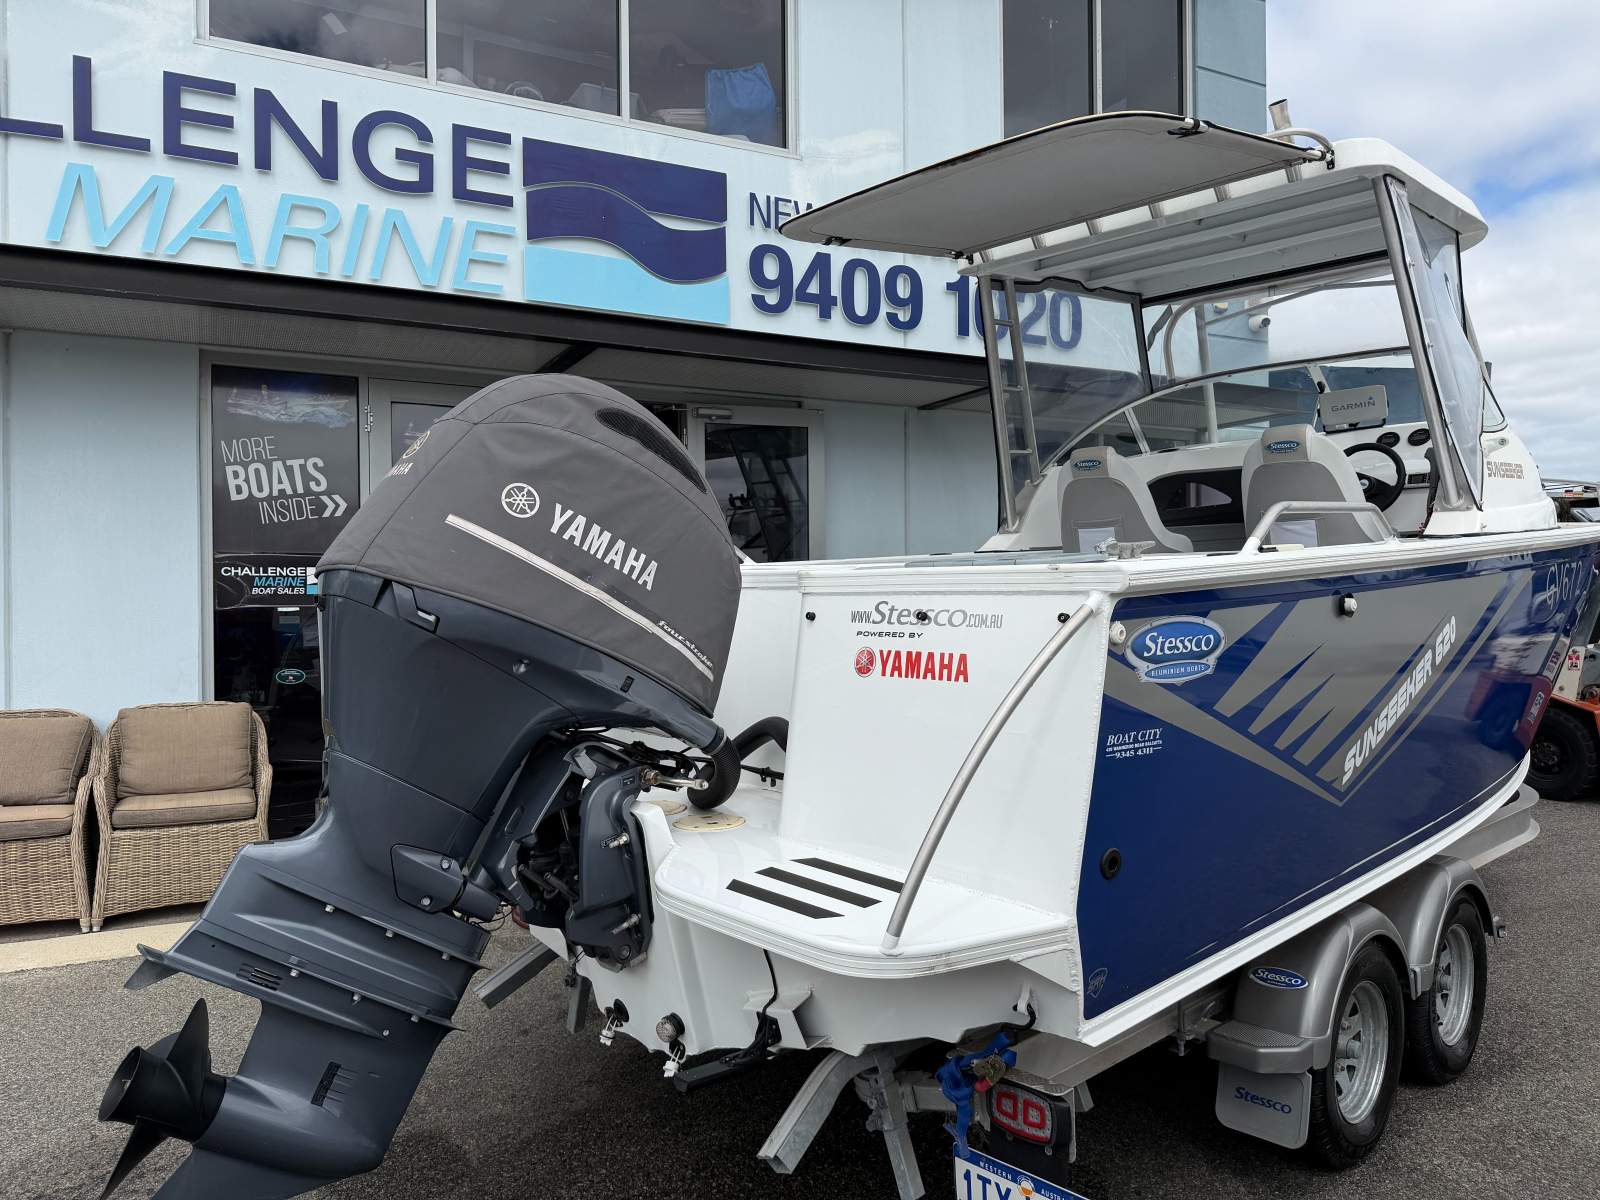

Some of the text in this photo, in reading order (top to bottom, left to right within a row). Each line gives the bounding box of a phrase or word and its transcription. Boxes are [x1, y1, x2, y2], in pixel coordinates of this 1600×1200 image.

[0, 55, 514, 208] LENGE
[45, 162, 517, 293] MARINE
[748, 244, 924, 331] 9409
[1331, 400, 1376, 412] GARMIN
[221, 436, 278, 463] MORE
[225, 457, 328, 501] BOATS
[258, 496, 319, 524] INSIDE
[550, 502, 658, 590] YAMAHA
[221, 566, 306, 576] CHALLENGE
[253, 577, 305, 586] MARINE
[251, 587, 305, 595] BOAT SALES
[856, 630, 905, 638] POWERED
[1143, 632, 1215, 657] Stessco
[878, 648, 969, 683] YAMAHA
[1342, 615, 1456, 785] SUNSEEKER 620
[1107, 732, 1136, 746] BOAT
[1138, 728, 1162, 742] CITY
[1255, 968, 1302, 985] Stessco
[1234, 1086, 1292, 1114] Stessco
[979, 1160, 1013, 1180] WESTERN
